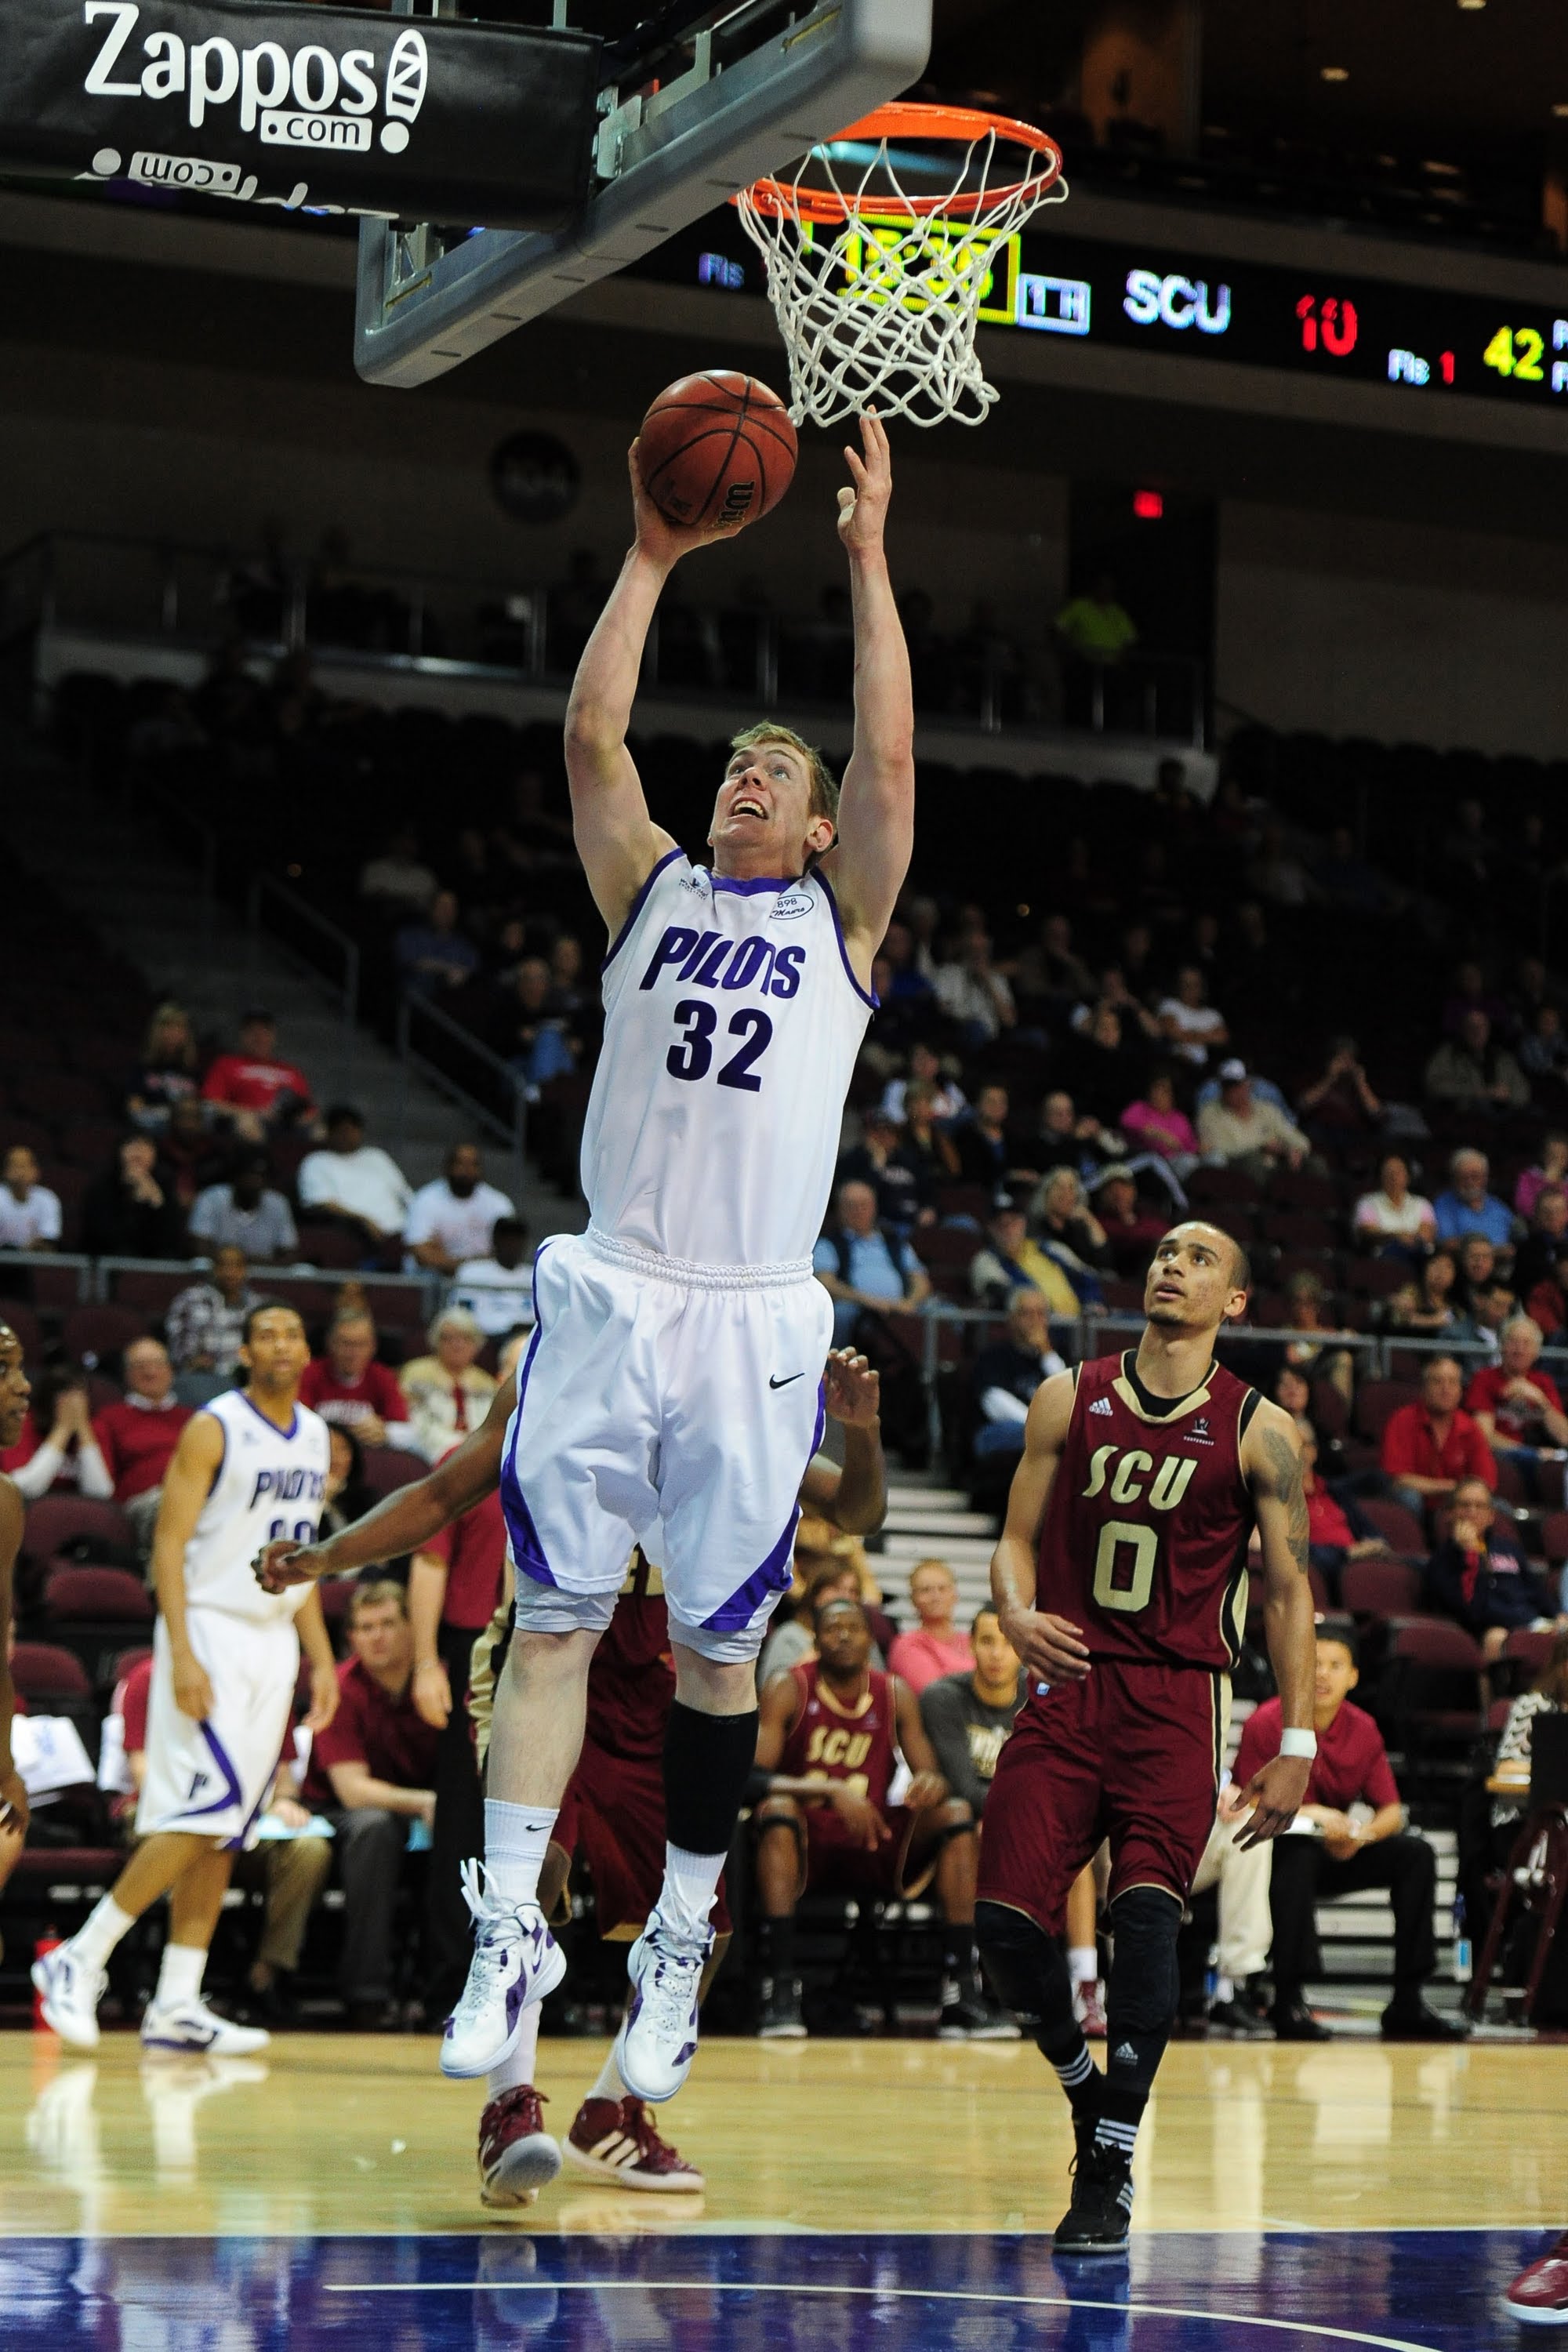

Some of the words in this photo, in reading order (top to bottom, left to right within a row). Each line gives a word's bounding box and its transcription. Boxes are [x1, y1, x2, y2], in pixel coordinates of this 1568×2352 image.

[84, 1, 378, 132] Zappos
[1123, 268, 1232, 335] SCU
[1295, 294, 1358, 357] 10
[1439, 350, 1455, 385] 1
[1483, 325, 1544, 382] 42
[777, 897, 797, 908] 898
[638, 925, 807, 1000] PILOTS
[666, 999, 774, 1092] 32
[1081, 1444, 1199, 1511] SCU
[1092, 1520, 1159, 1613] 0
